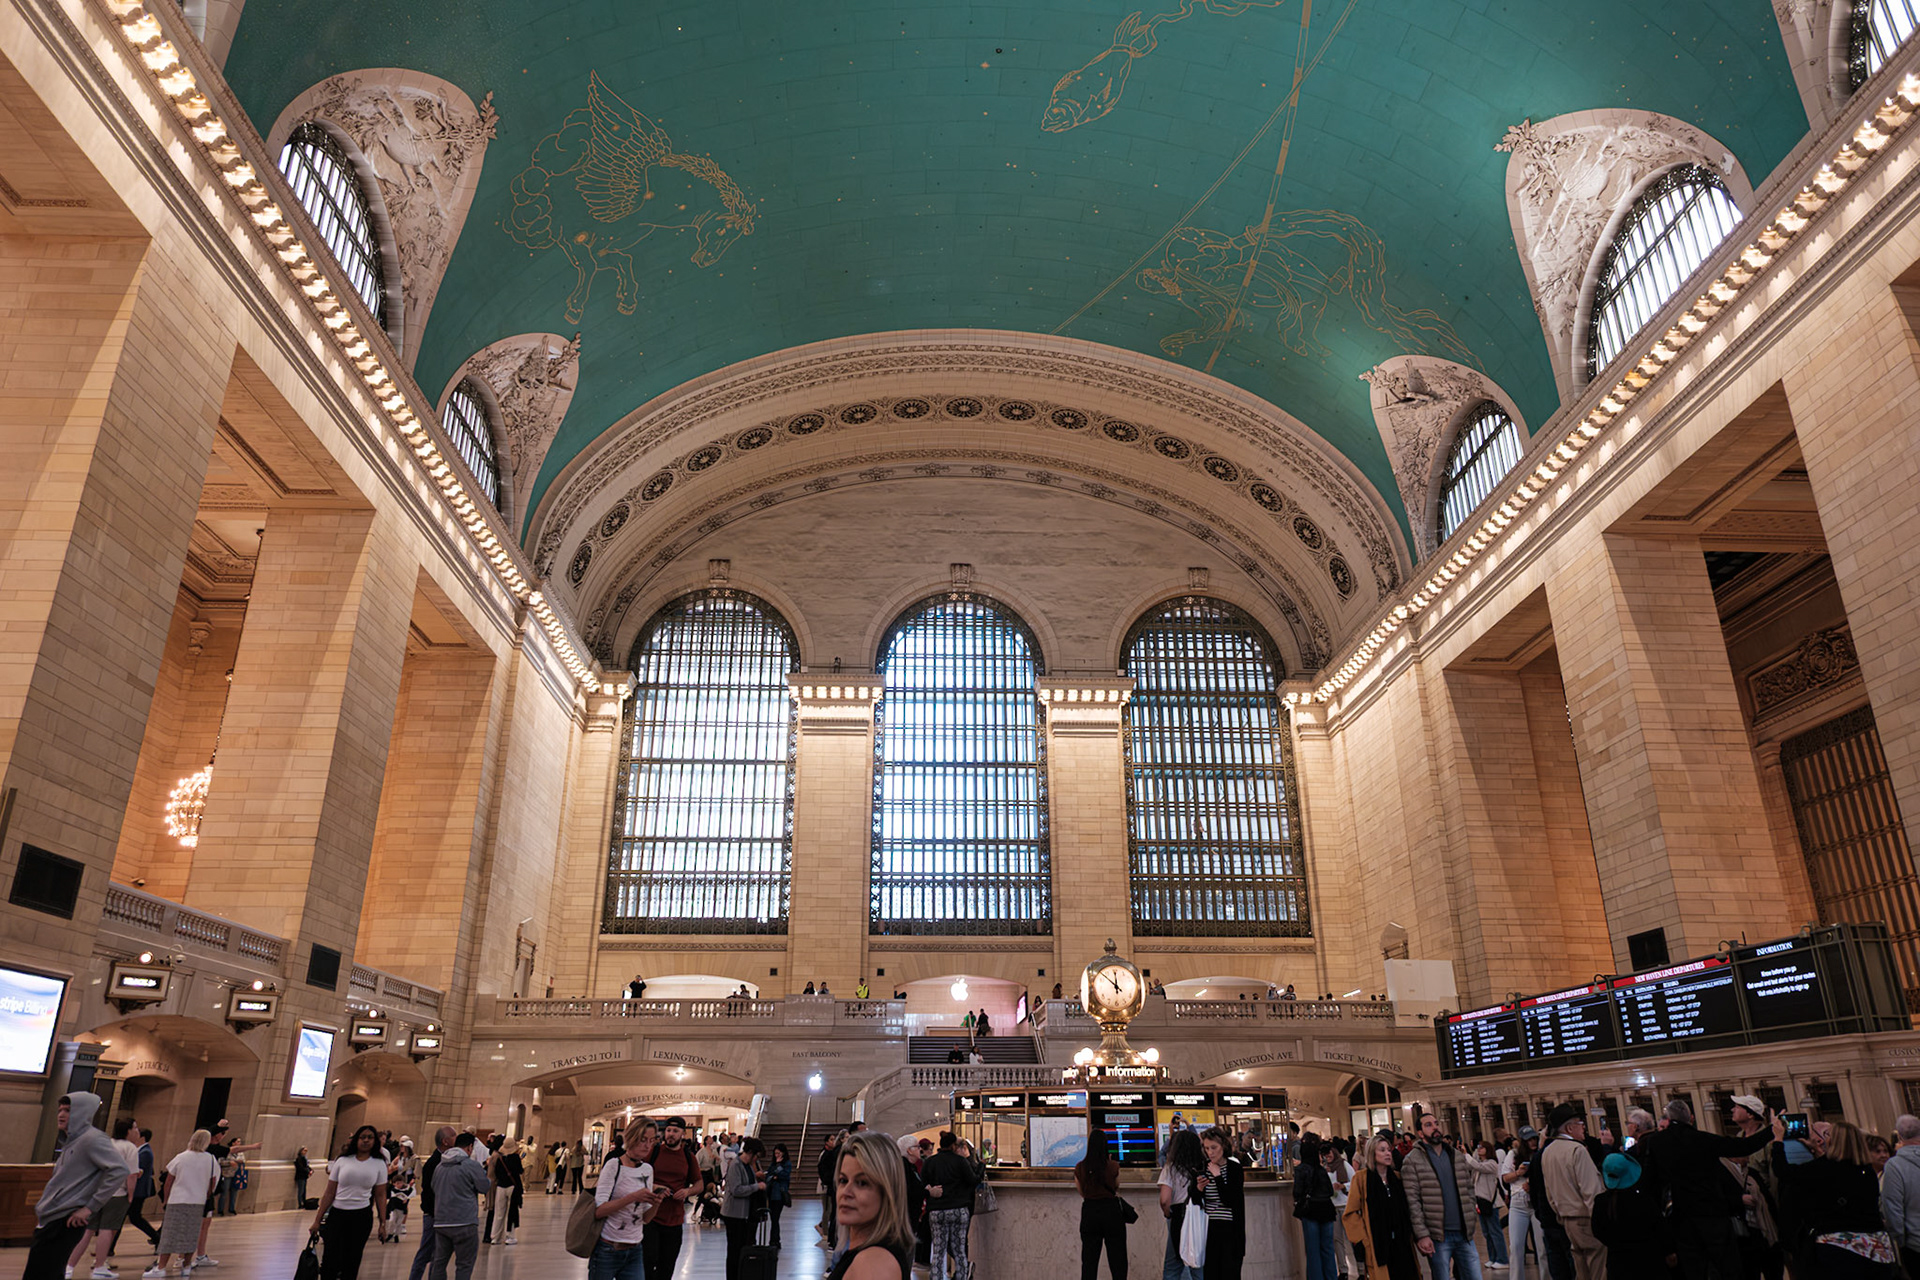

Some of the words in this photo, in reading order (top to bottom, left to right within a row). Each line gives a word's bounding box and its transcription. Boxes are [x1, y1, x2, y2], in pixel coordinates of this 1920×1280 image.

[1756, 942, 1793, 956] INFORMATION
[0, 996, 23, 1013] stripe
[552, 1055, 587, 1068] TRACKS
[600, 1052, 612, 1060] TO
[653, 1051, 706, 1065] LEXINGTON
[708, 1059, 726, 1069] AVE
[1223, 1054, 1275, 1070] LEXINGTON
[1277, 1051, 1294, 1060] AVE
[1324, 1051, 1354, 1061] TICKET
[1357, 1056, 1403, 1072] MACHINES
[1105, 1066, 1156, 1076] Information
[603, 1100, 623, 1109] 42ND
[624, 1095, 651, 1104] STREET
[915, 1119, 939, 1128] TRACKS
